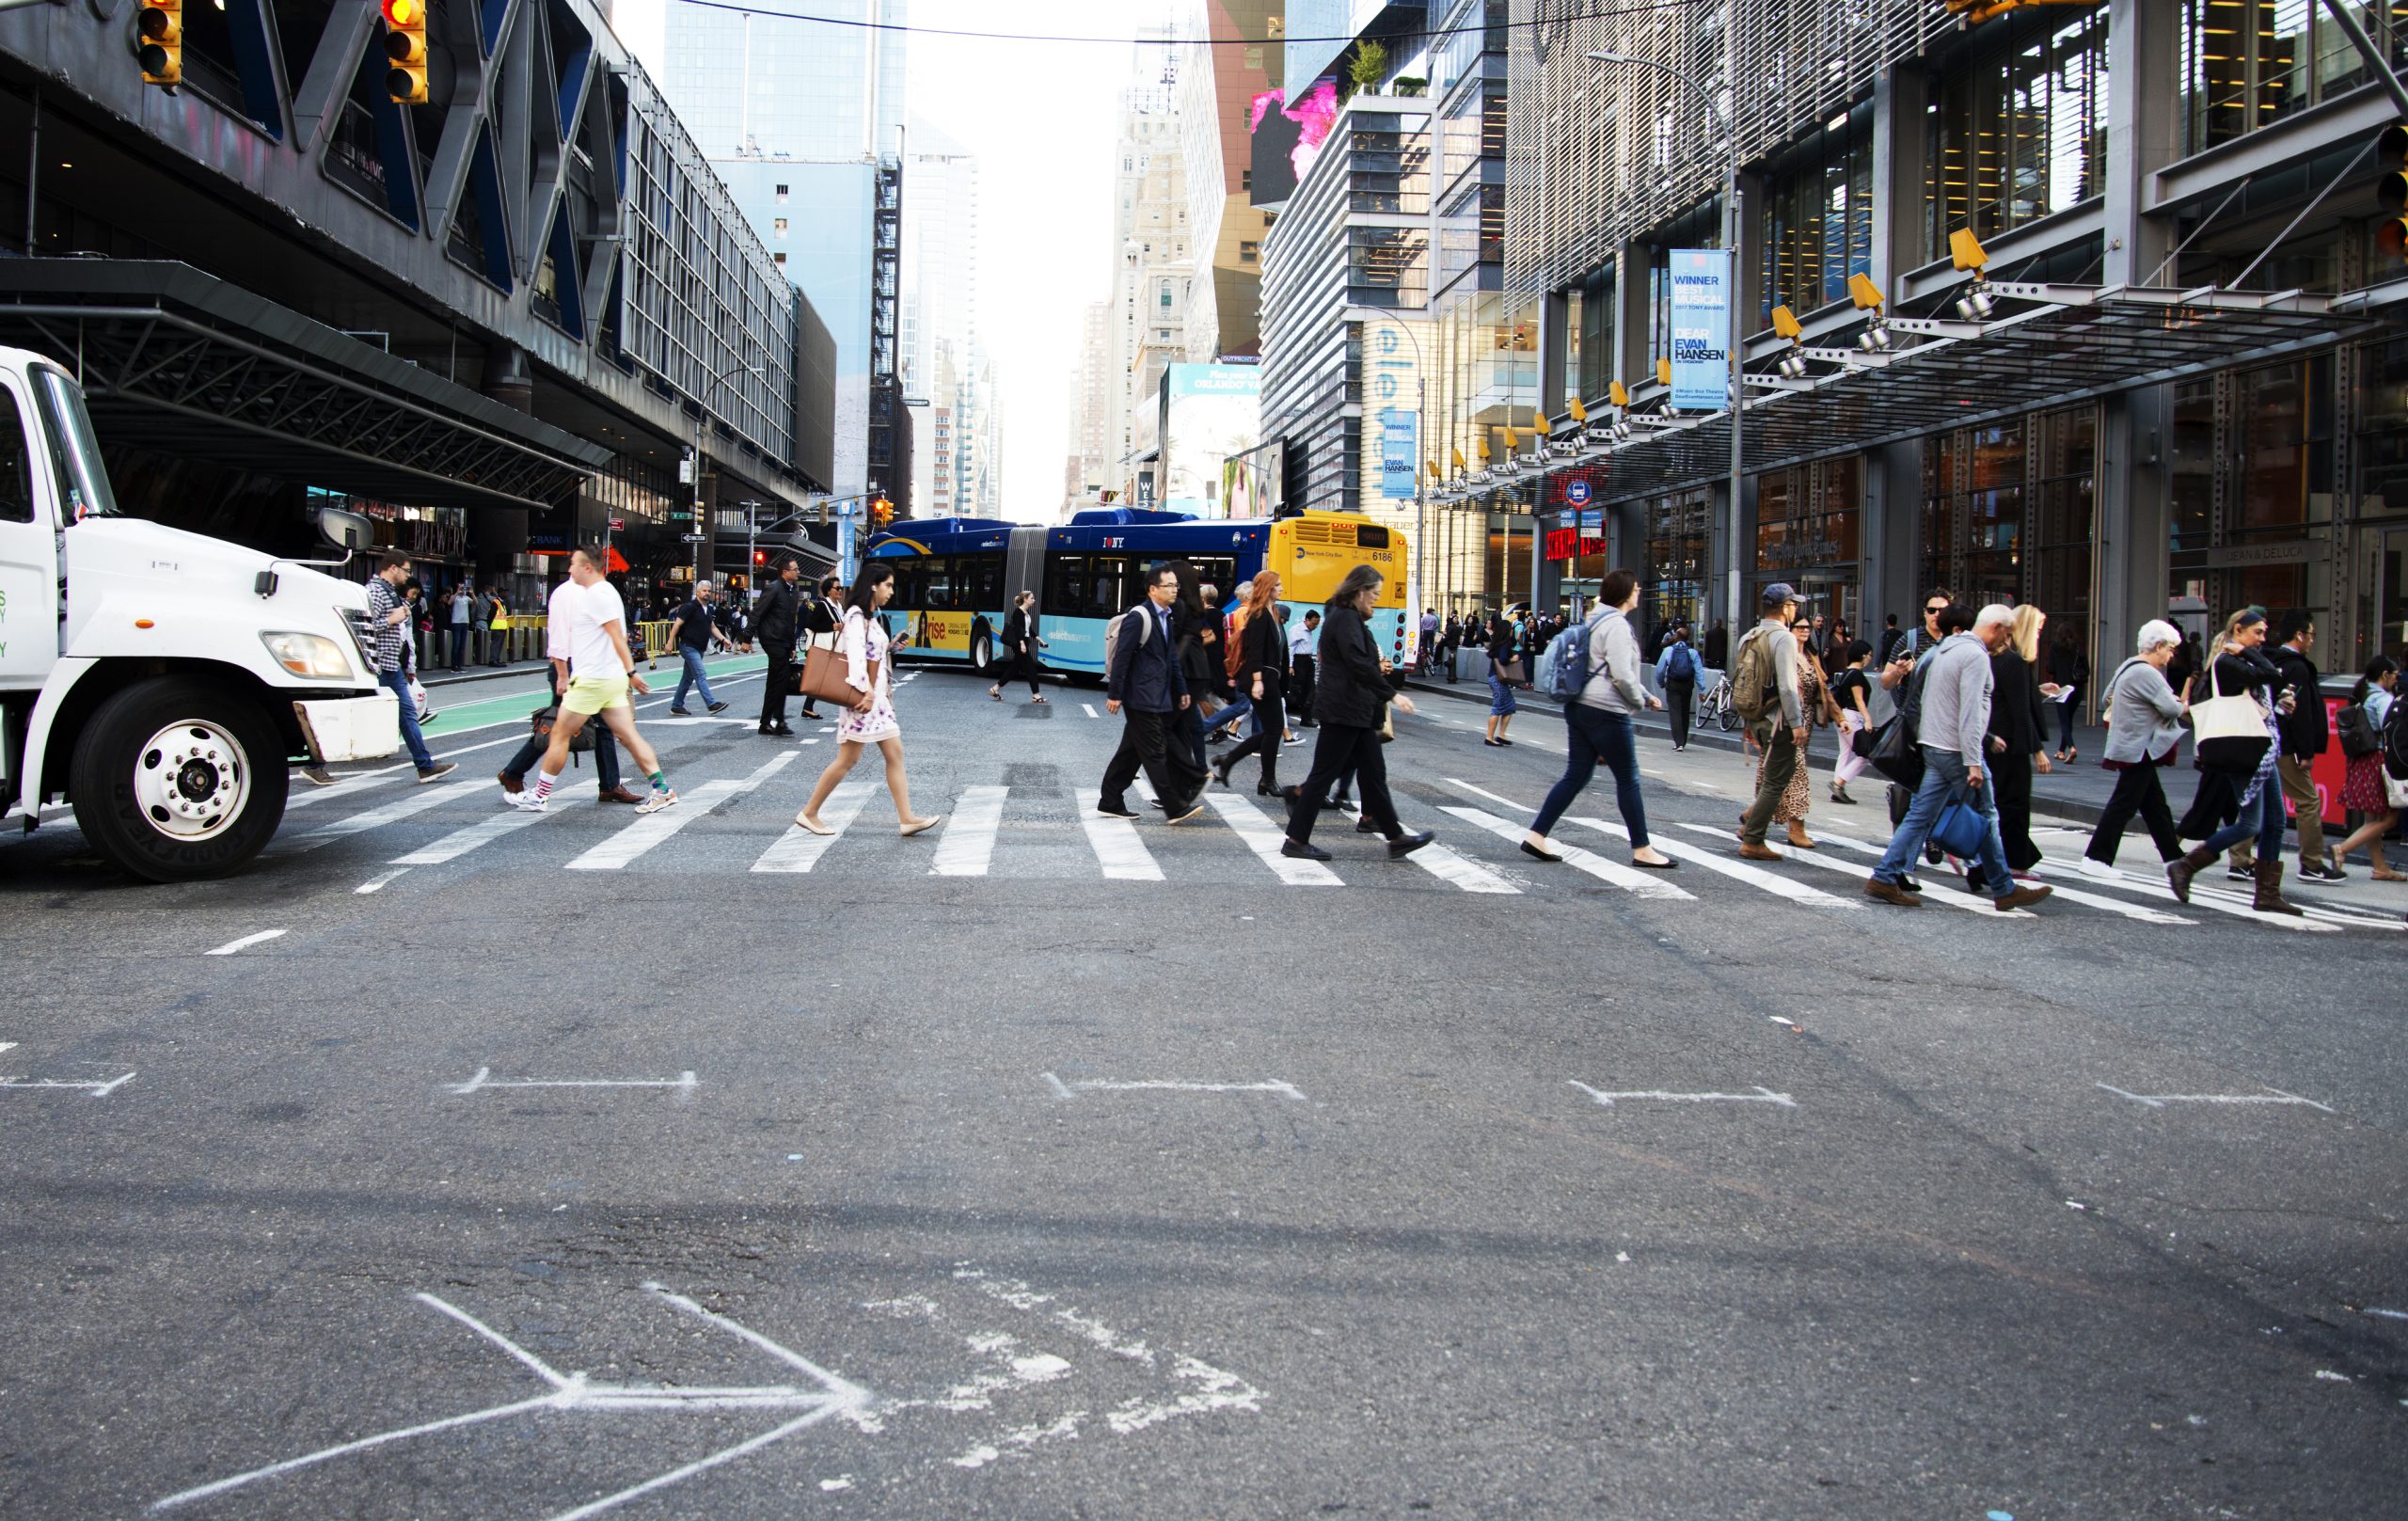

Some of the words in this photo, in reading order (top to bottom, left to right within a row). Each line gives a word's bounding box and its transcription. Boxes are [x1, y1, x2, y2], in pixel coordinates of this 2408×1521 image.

[1674, 276, 1719, 285] WINNER
[1675, 285, 1703, 294] BEST
[1675, 294, 1724, 304] MUSICAL
[1675, 328, 1709, 339] DEAR
[1675, 339, 1707, 349] EVAN
[1675, 349, 1725, 360] HANSEN
[414, 520, 468, 558] BREWERY
[537, 535, 562, 544] BANK
[1372, 551, 1393, 562] 6186
[2226, 548, 2253, 562] DEAN
[2263, 547, 2304, 559] DELUCA
[844, 541, 854, 581] pharmacy
[909, 616, 919, 638] all
